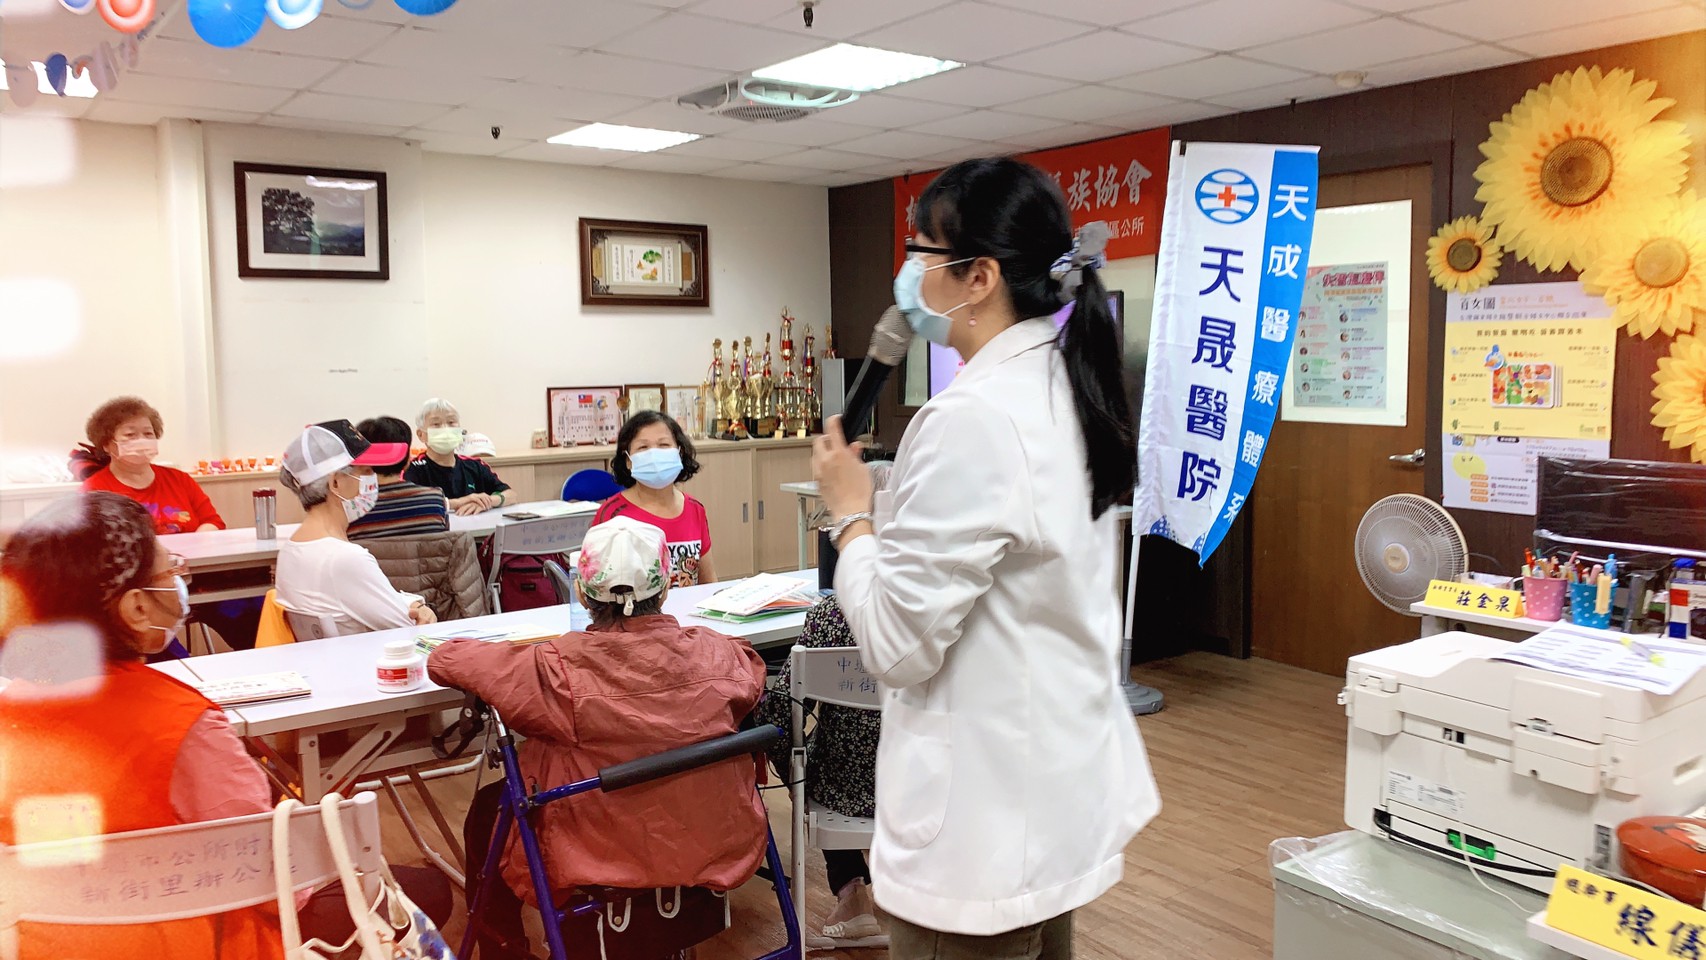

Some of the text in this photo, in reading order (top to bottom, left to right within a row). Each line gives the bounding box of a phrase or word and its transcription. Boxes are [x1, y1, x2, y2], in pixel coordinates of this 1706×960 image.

[1177, 246, 1244, 502] 天晟醫院
[1223, 184, 1310, 523] 天成醫療體系
